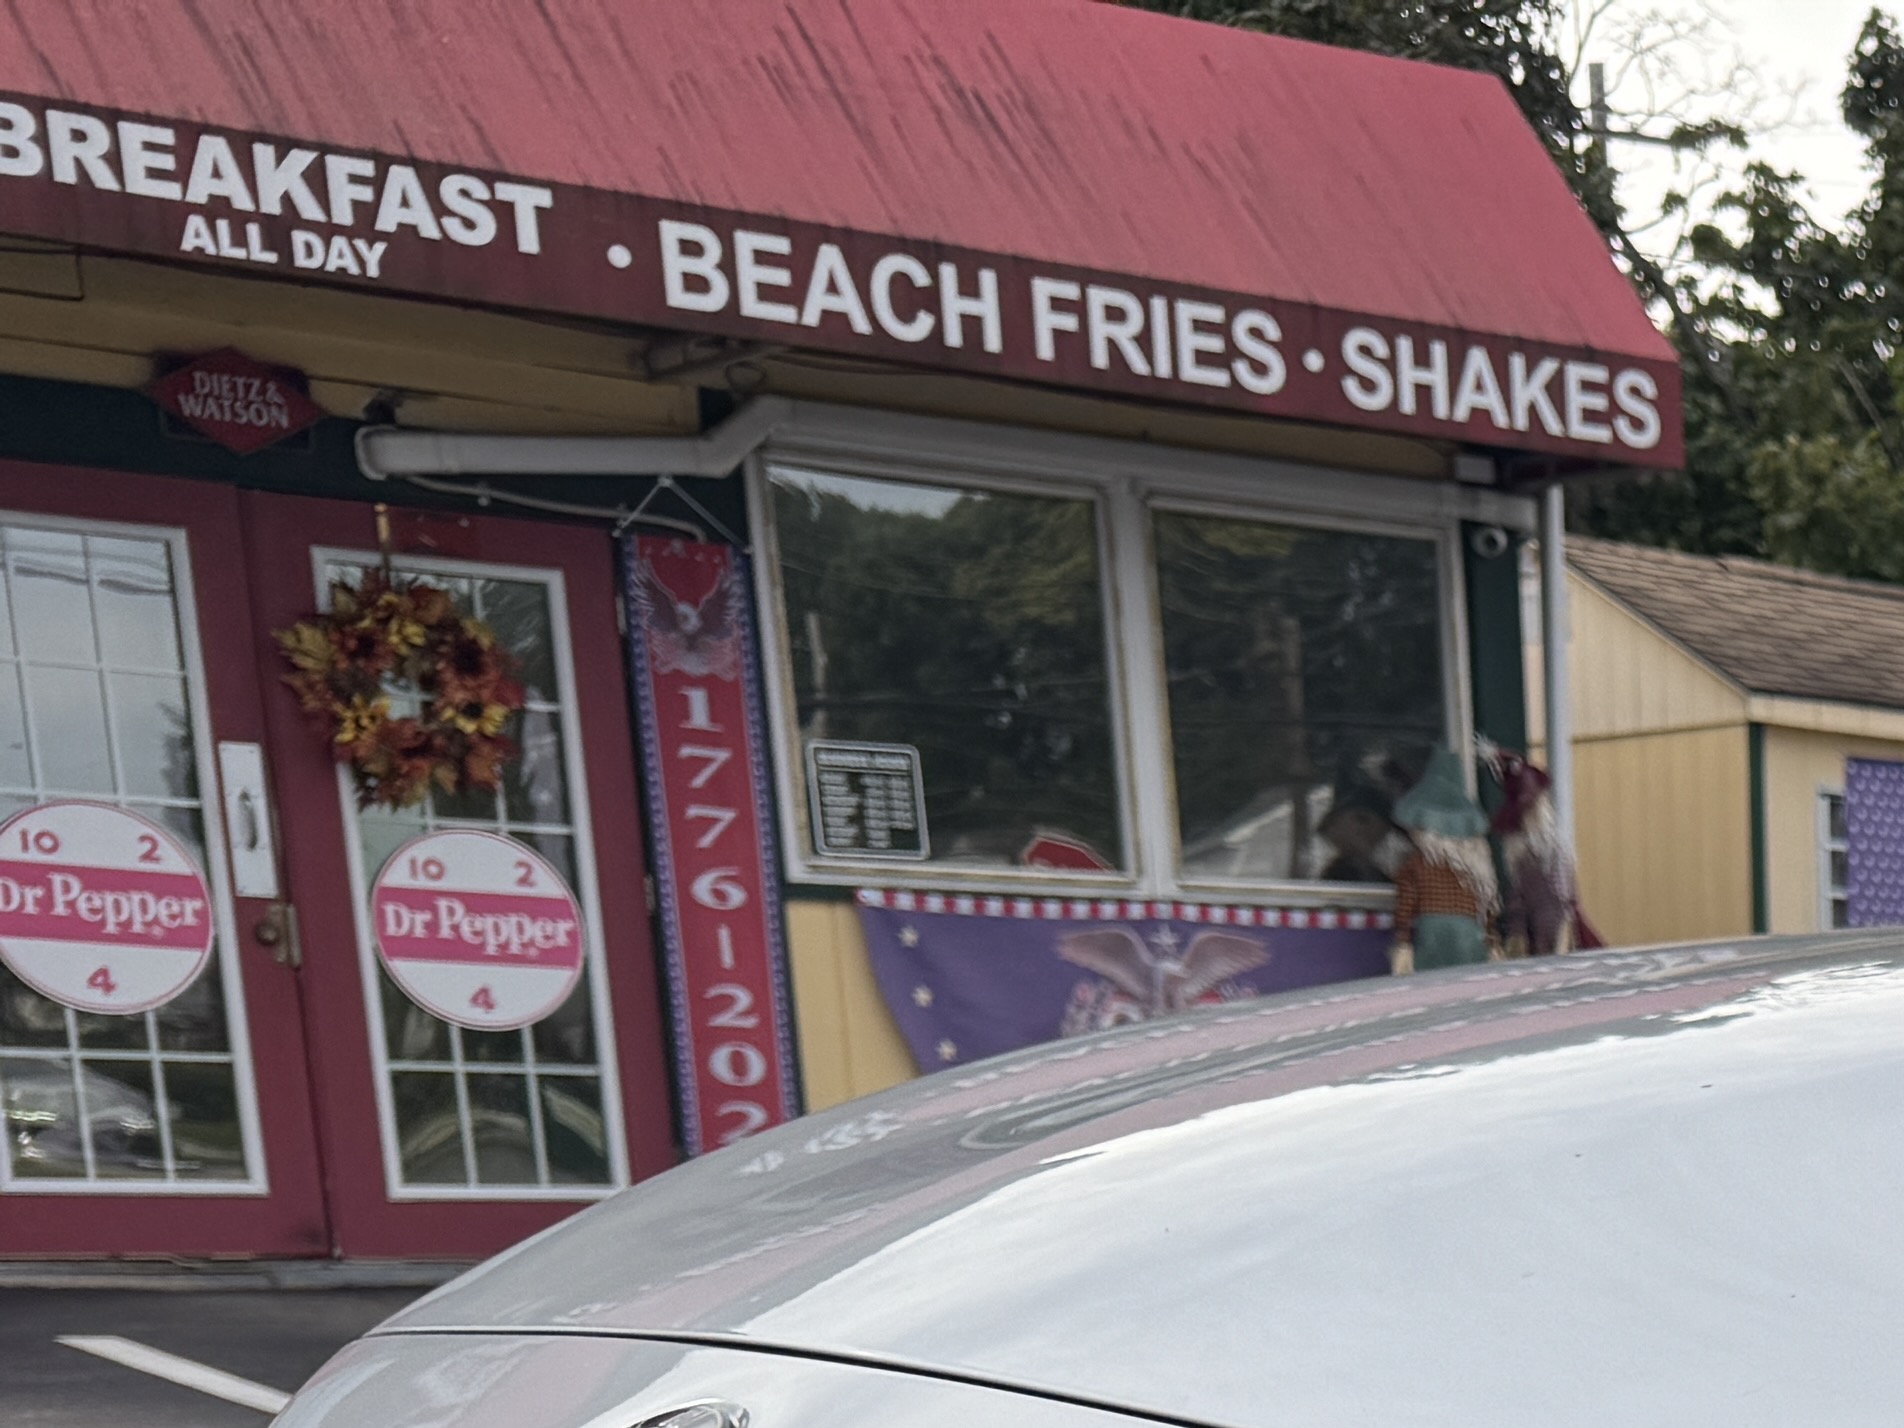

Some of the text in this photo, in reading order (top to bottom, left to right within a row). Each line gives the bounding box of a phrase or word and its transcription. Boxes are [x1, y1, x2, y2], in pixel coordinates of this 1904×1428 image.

[0, 101, 553, 255] BREAKFAST
[180, 213, 388, 278] ALL DAY
[658, 219, 1662, 450] BEACH FRIES SHAKES
[192, 370, 264, 402] DIETZ
[177, 392, 290, 429] WATSON
[19, 828, 163, 864] 10 2
[408, 856, 538, 888] 10 2
[0, 871, 204, 934] Dr Pepper
[381, 896, 575, 956] Dr Pepper
[86, 966, 118, 996] 4
[468, 984, 496, 1014] 4
